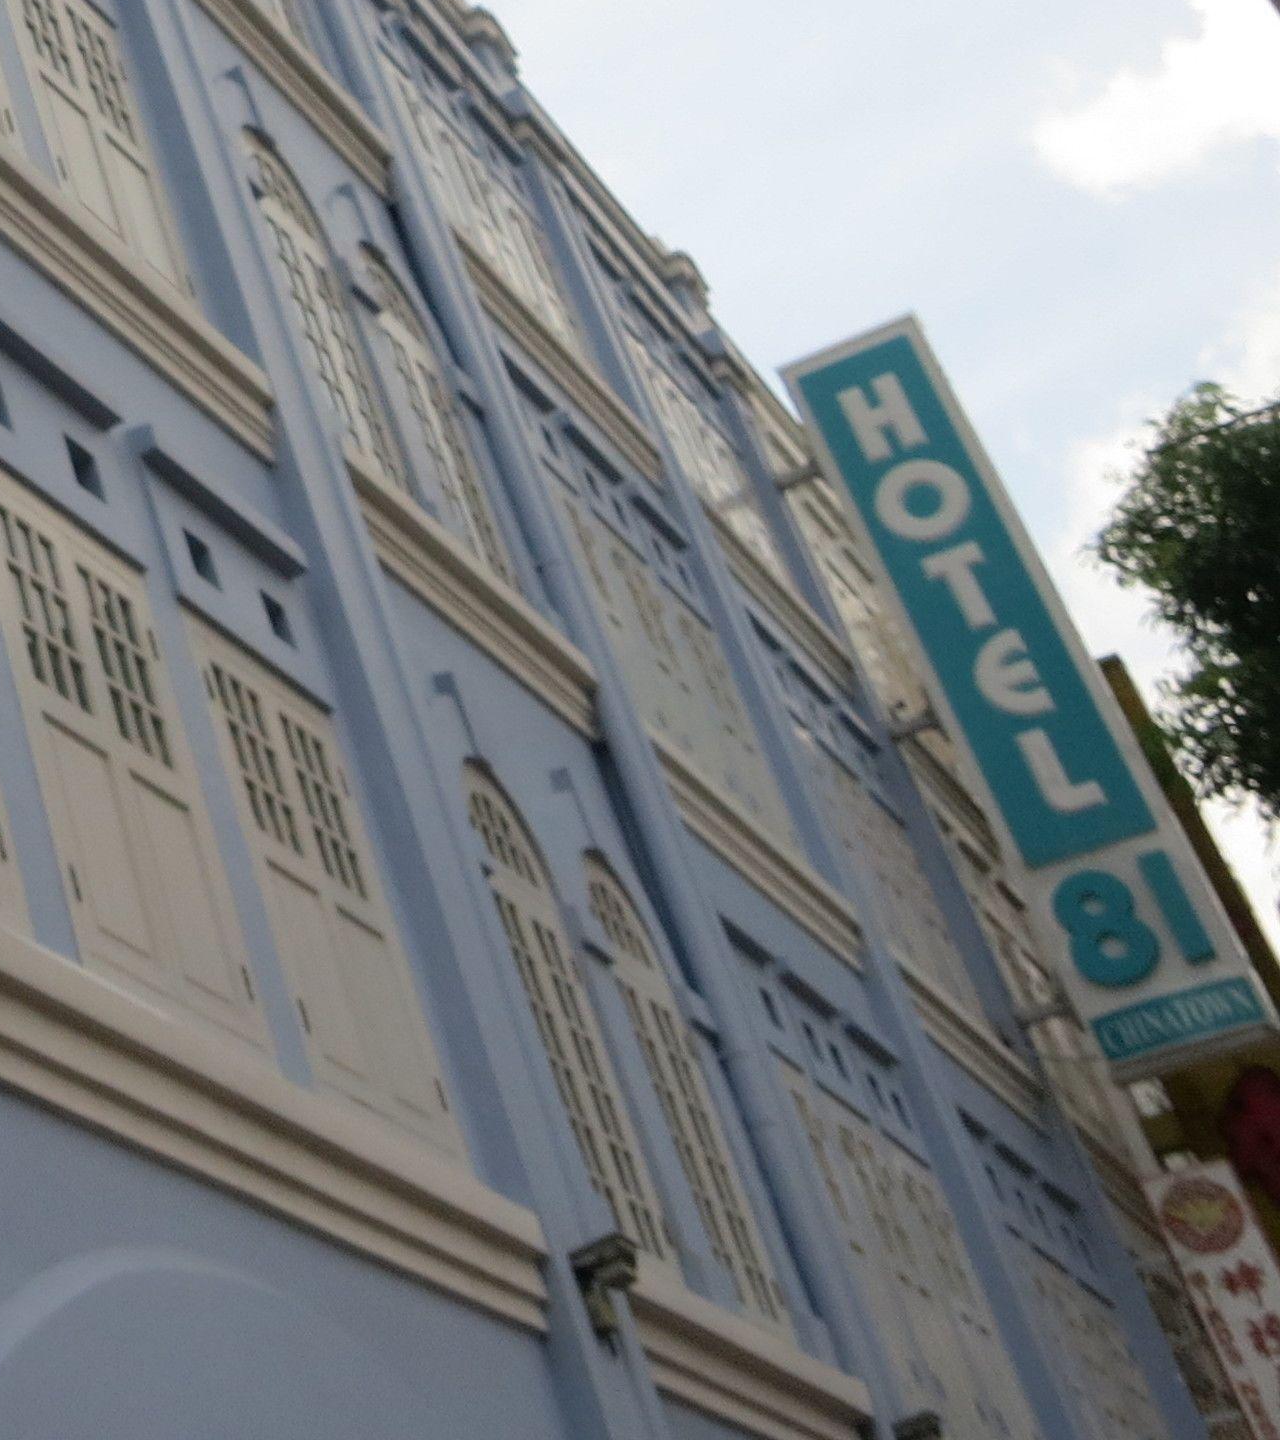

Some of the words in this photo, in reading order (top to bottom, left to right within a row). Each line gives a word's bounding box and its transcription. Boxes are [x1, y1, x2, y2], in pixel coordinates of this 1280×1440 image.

[837, 371, 1107, 815] HOTEL
[1052, 848, 1217, 988] 81
[1100, 985, 1256, 1053] CHINATOWN
